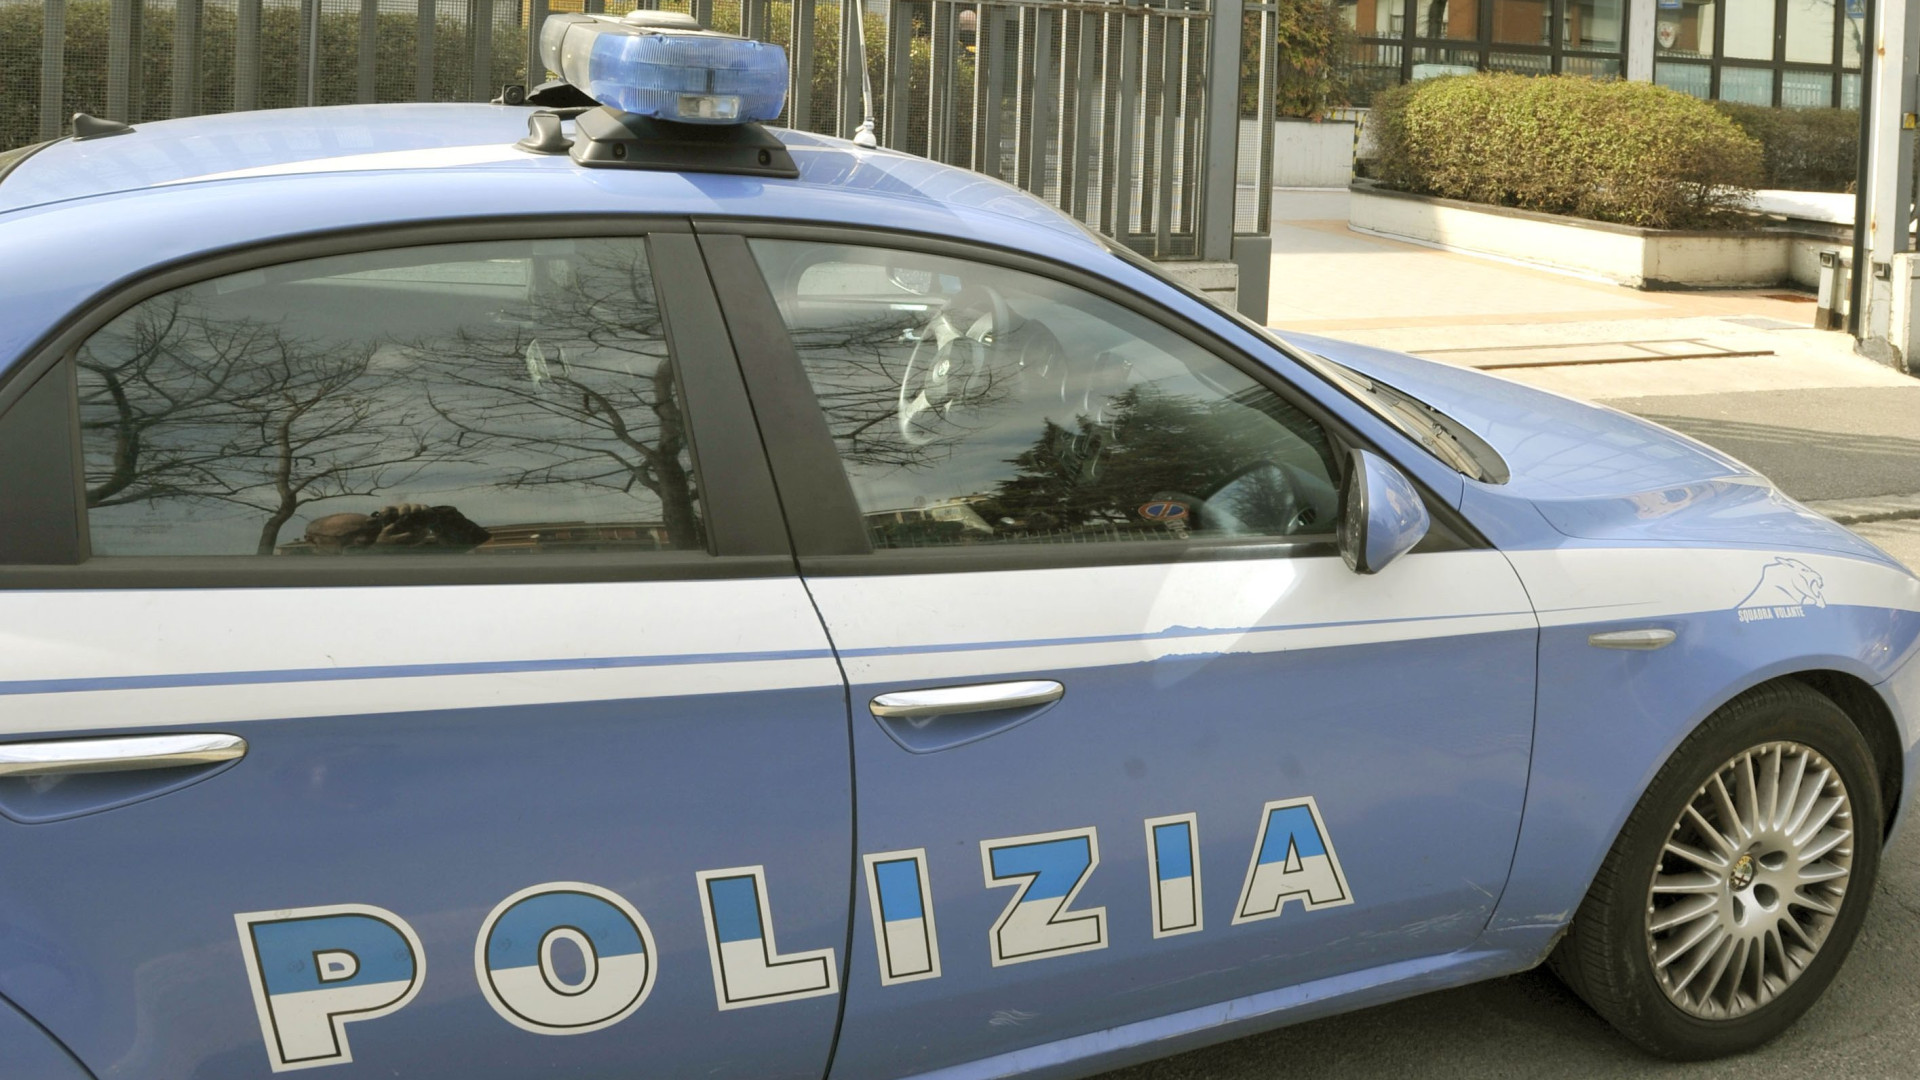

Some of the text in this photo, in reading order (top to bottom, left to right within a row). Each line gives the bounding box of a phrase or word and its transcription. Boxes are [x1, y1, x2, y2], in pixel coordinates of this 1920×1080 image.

[1738, 606, 1805, 623] SQUADRA VOLANTE
[235, 796, 1353, 1072] POLIZIA
